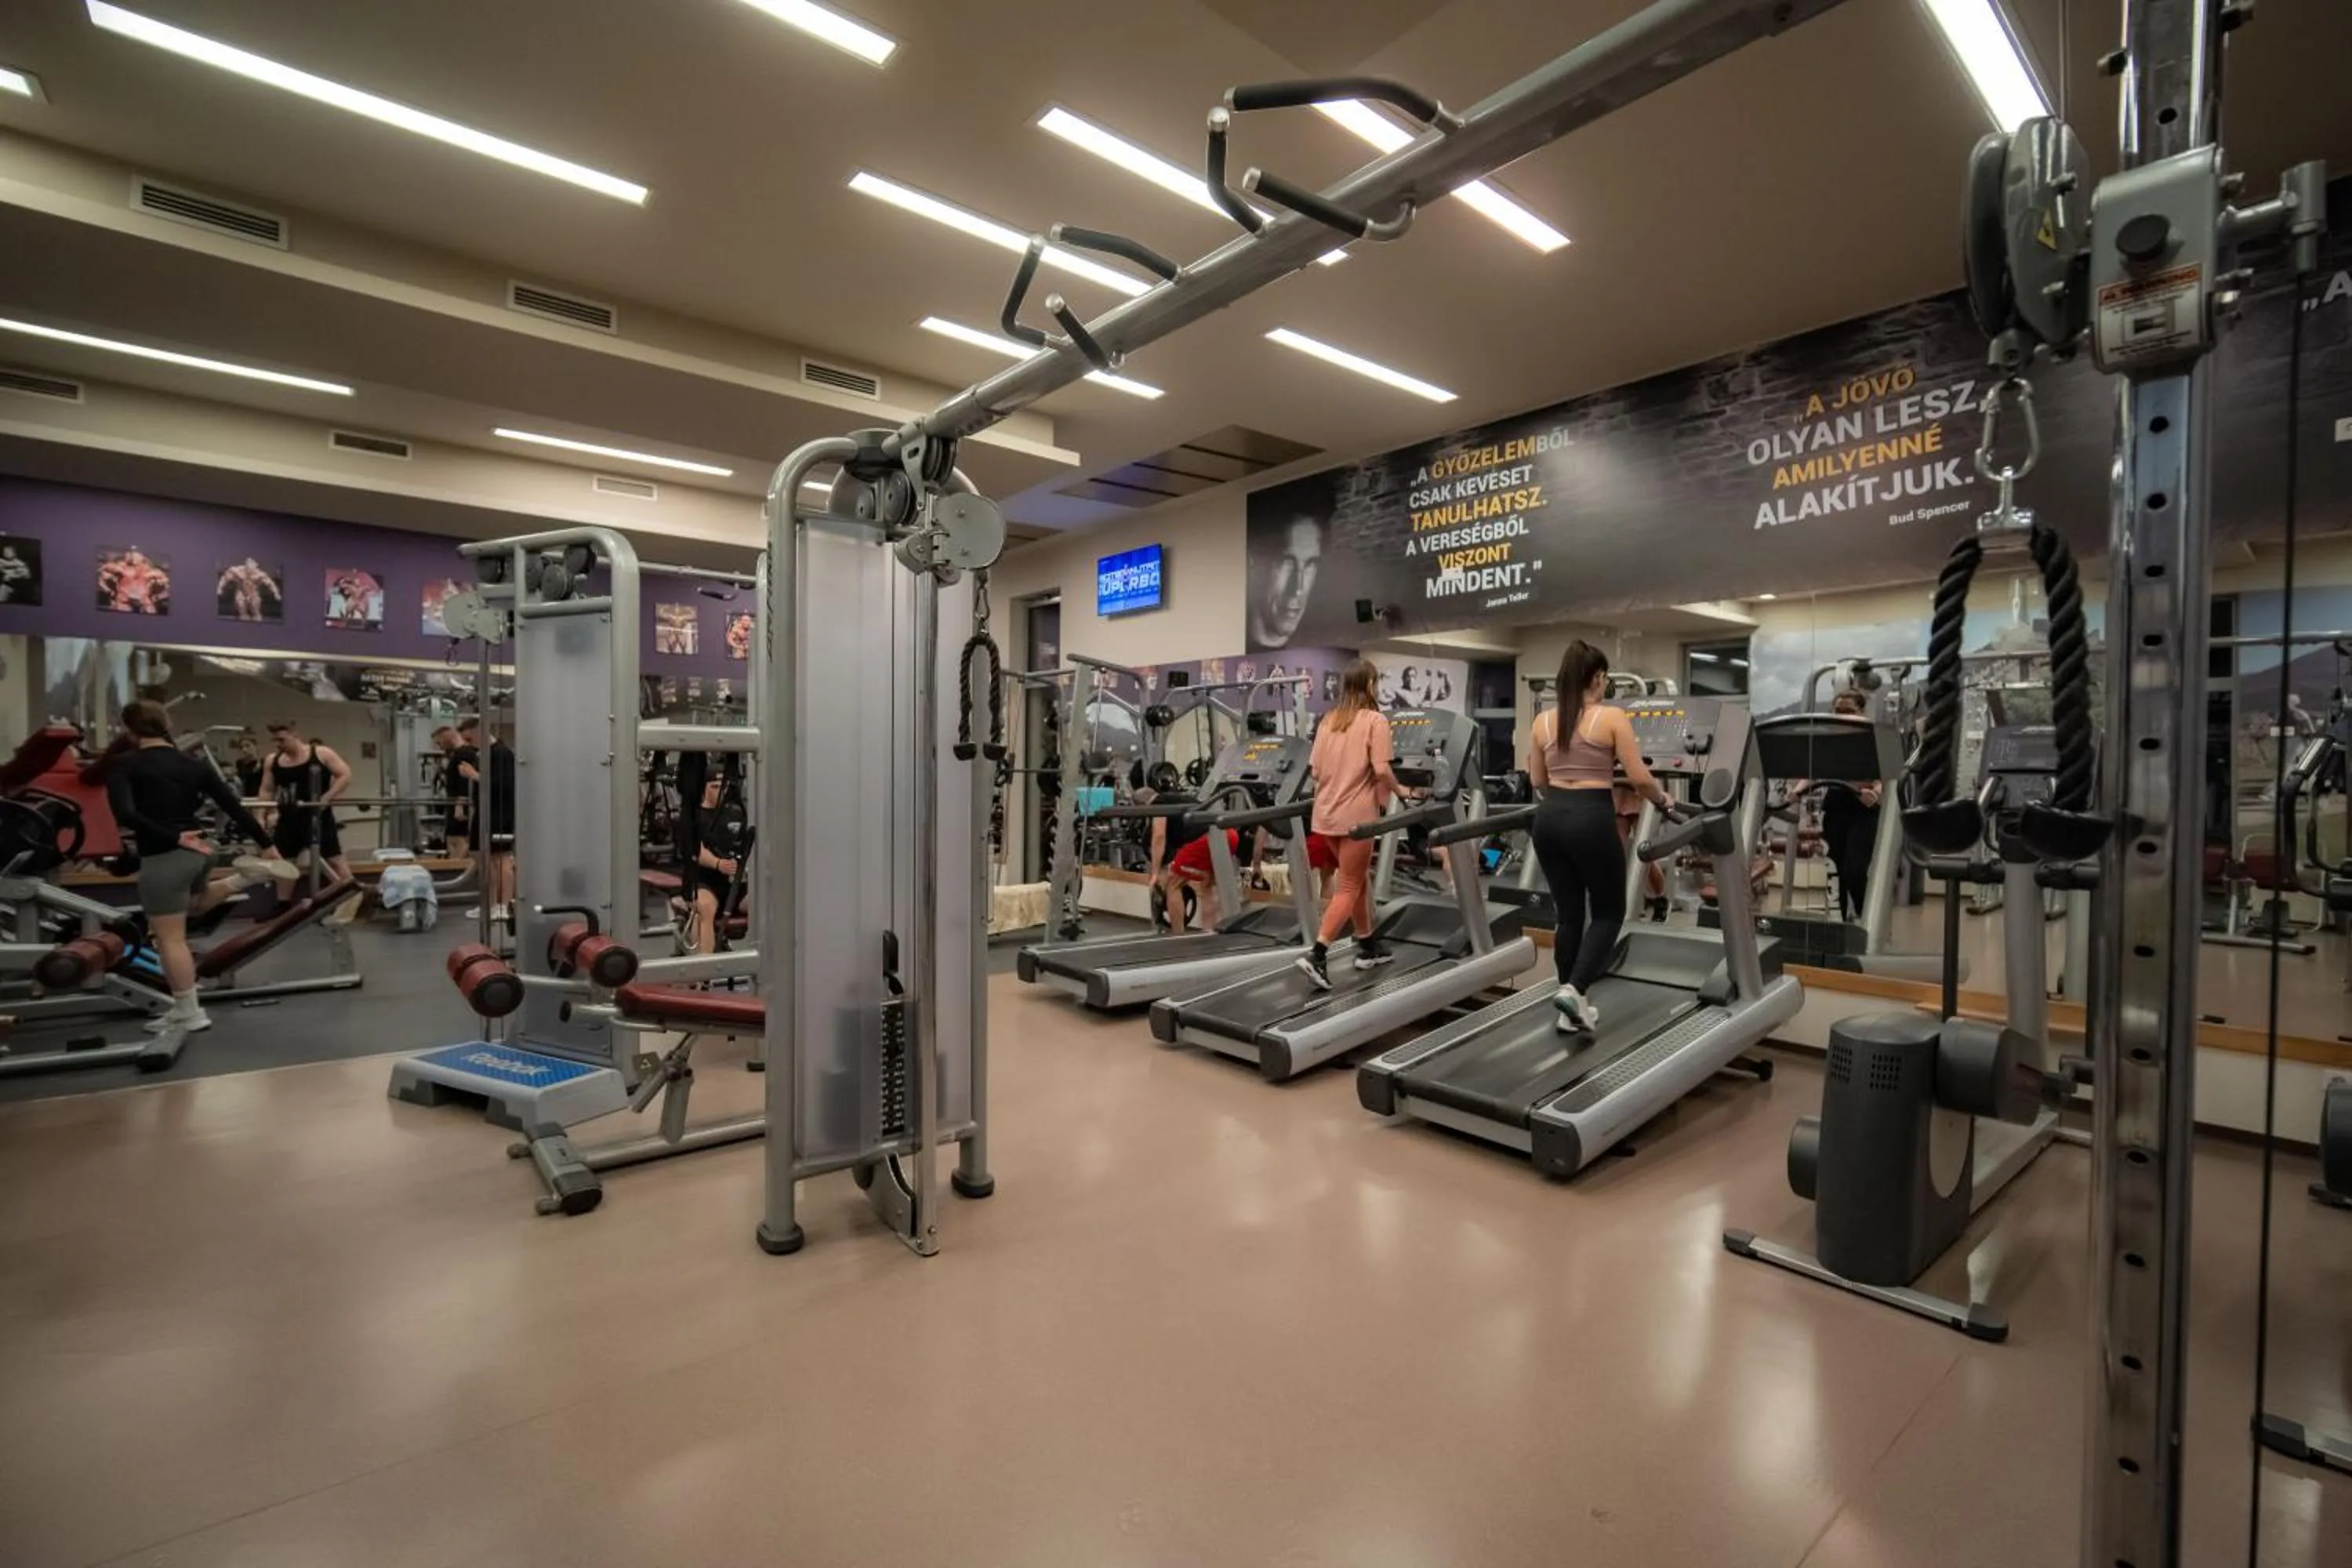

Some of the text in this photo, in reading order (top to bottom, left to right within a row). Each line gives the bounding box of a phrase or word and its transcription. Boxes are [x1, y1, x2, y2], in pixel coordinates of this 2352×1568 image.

[1747, 412, 1864, 466] OLYAN
[1772, 423, 1944, 490] AMILYENNÉ
[1409, 464, 1534, 509] CSAK KEVESET
[1411, 486, 1548, 532] TANULHATSZ.
[1754, 457, 1975, 531] ALAKÍTJUK.
[1889, 500, 1971, 525] Bud Spencer
[1405, 514, 1530, 557] A VERESÉGBŐL
[1438, 543, 1512, 569] VISZONT
